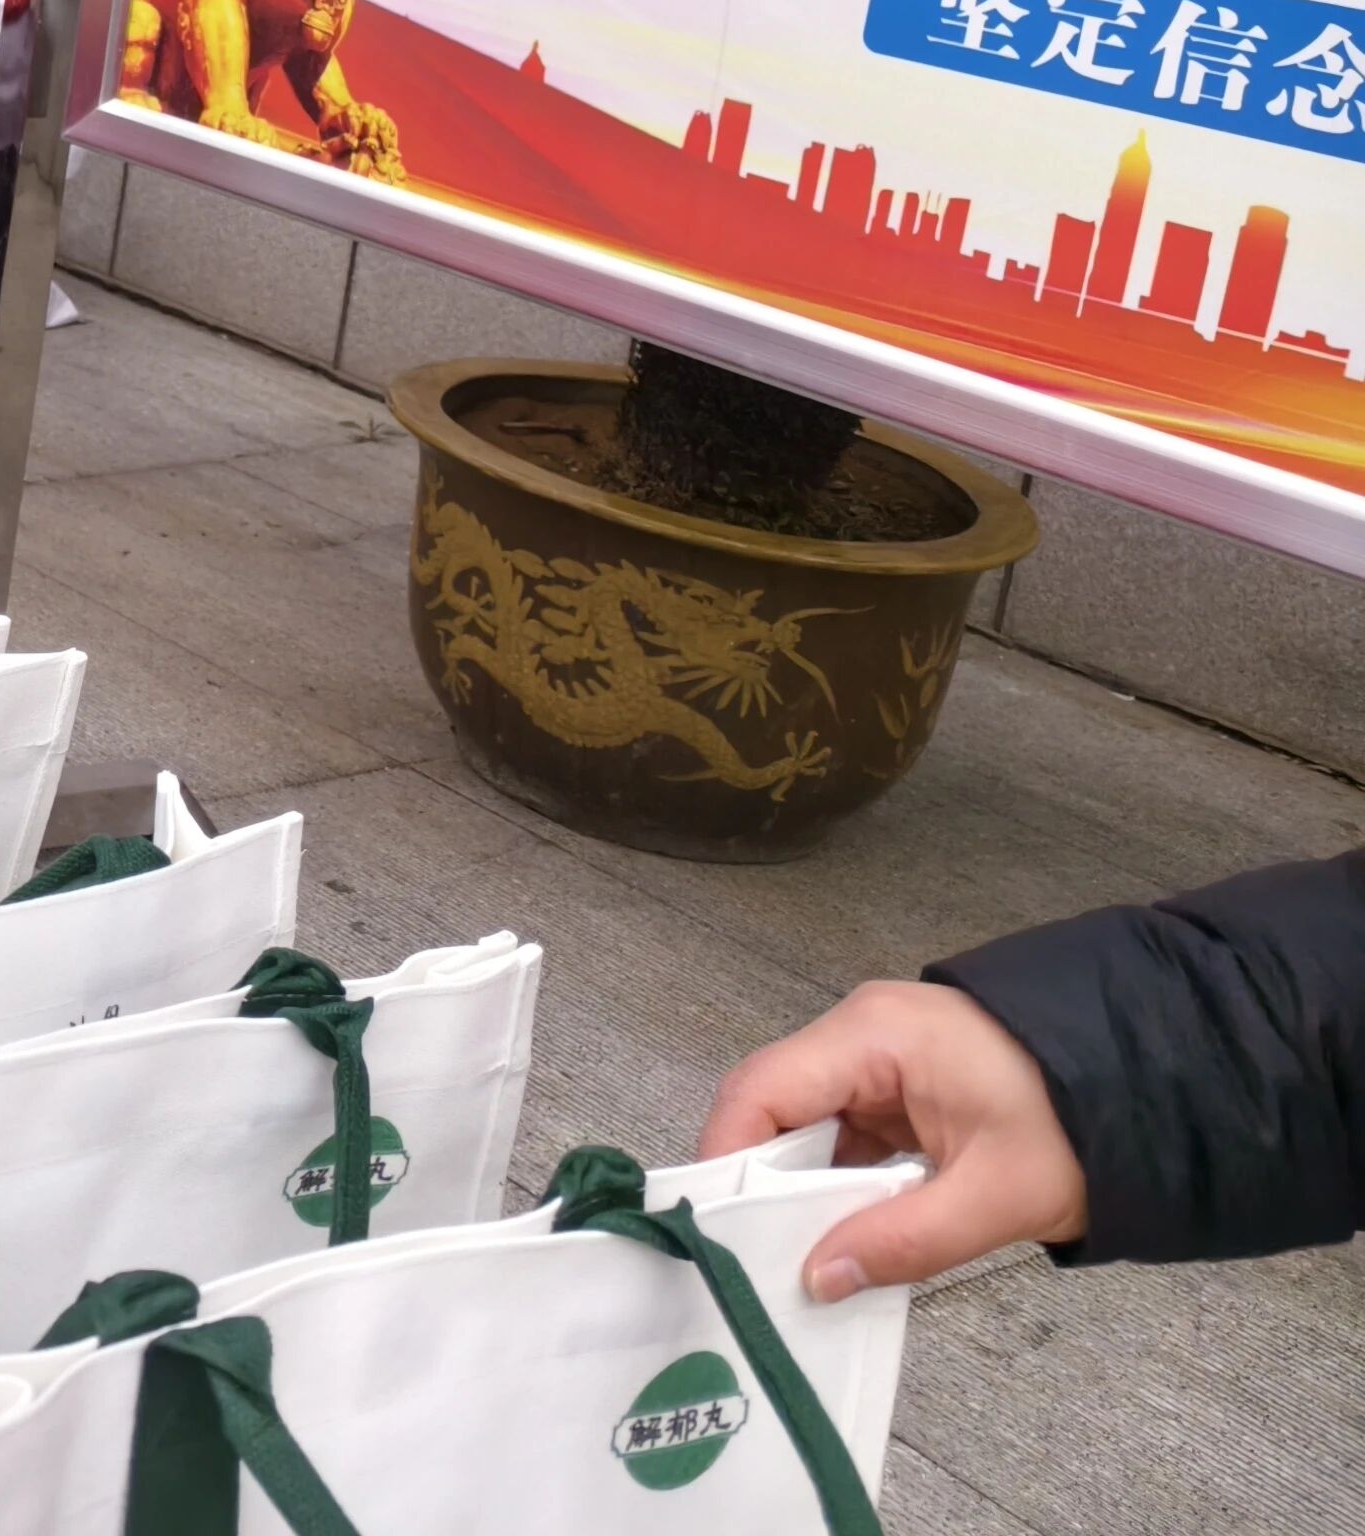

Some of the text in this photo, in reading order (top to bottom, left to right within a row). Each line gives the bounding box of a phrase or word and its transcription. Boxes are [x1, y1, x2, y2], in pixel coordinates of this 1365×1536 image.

[295, 1156, 394, 1195] 解丸
[625, 1401, 731, 1452] 解郁丸
